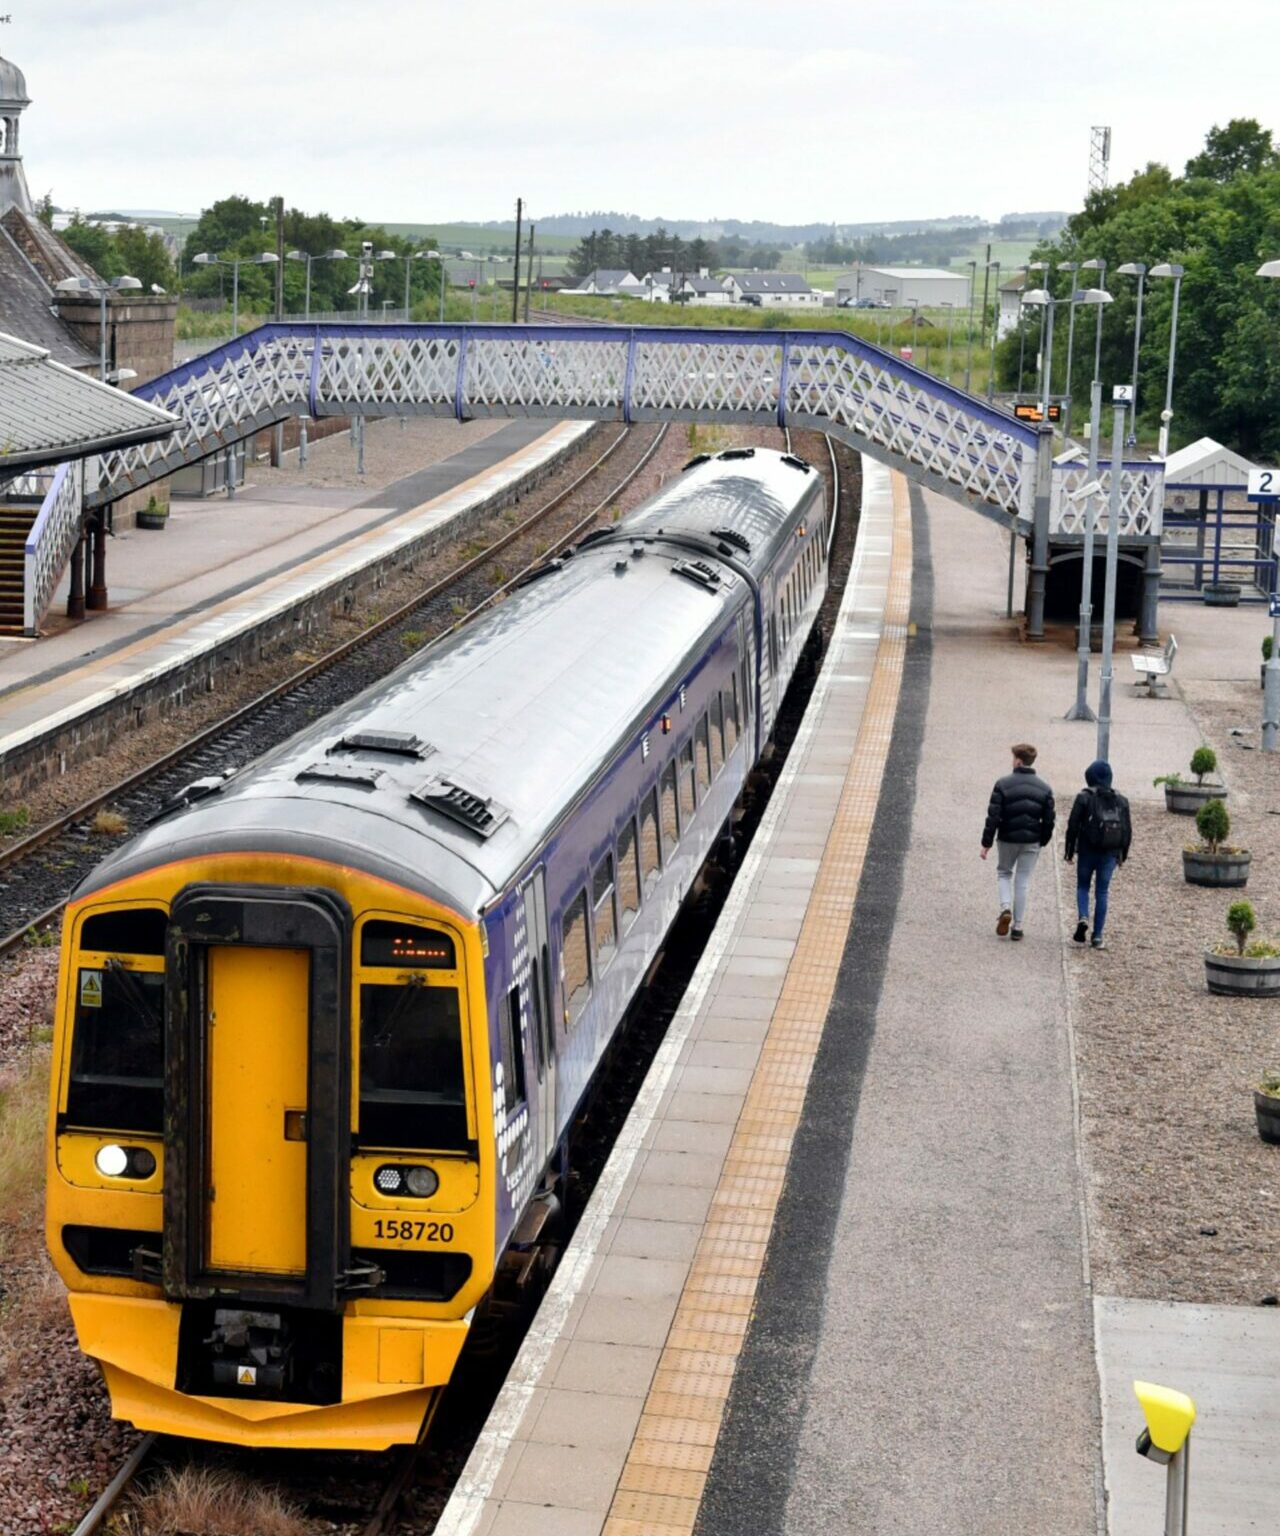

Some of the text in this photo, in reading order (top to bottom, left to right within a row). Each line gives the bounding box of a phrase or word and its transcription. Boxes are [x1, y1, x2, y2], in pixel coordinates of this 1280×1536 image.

[1118, 387, 1127, 399] 2
[1258, 472, 1273, 493] 2
[374, 1219, 454, 1243] 158720
